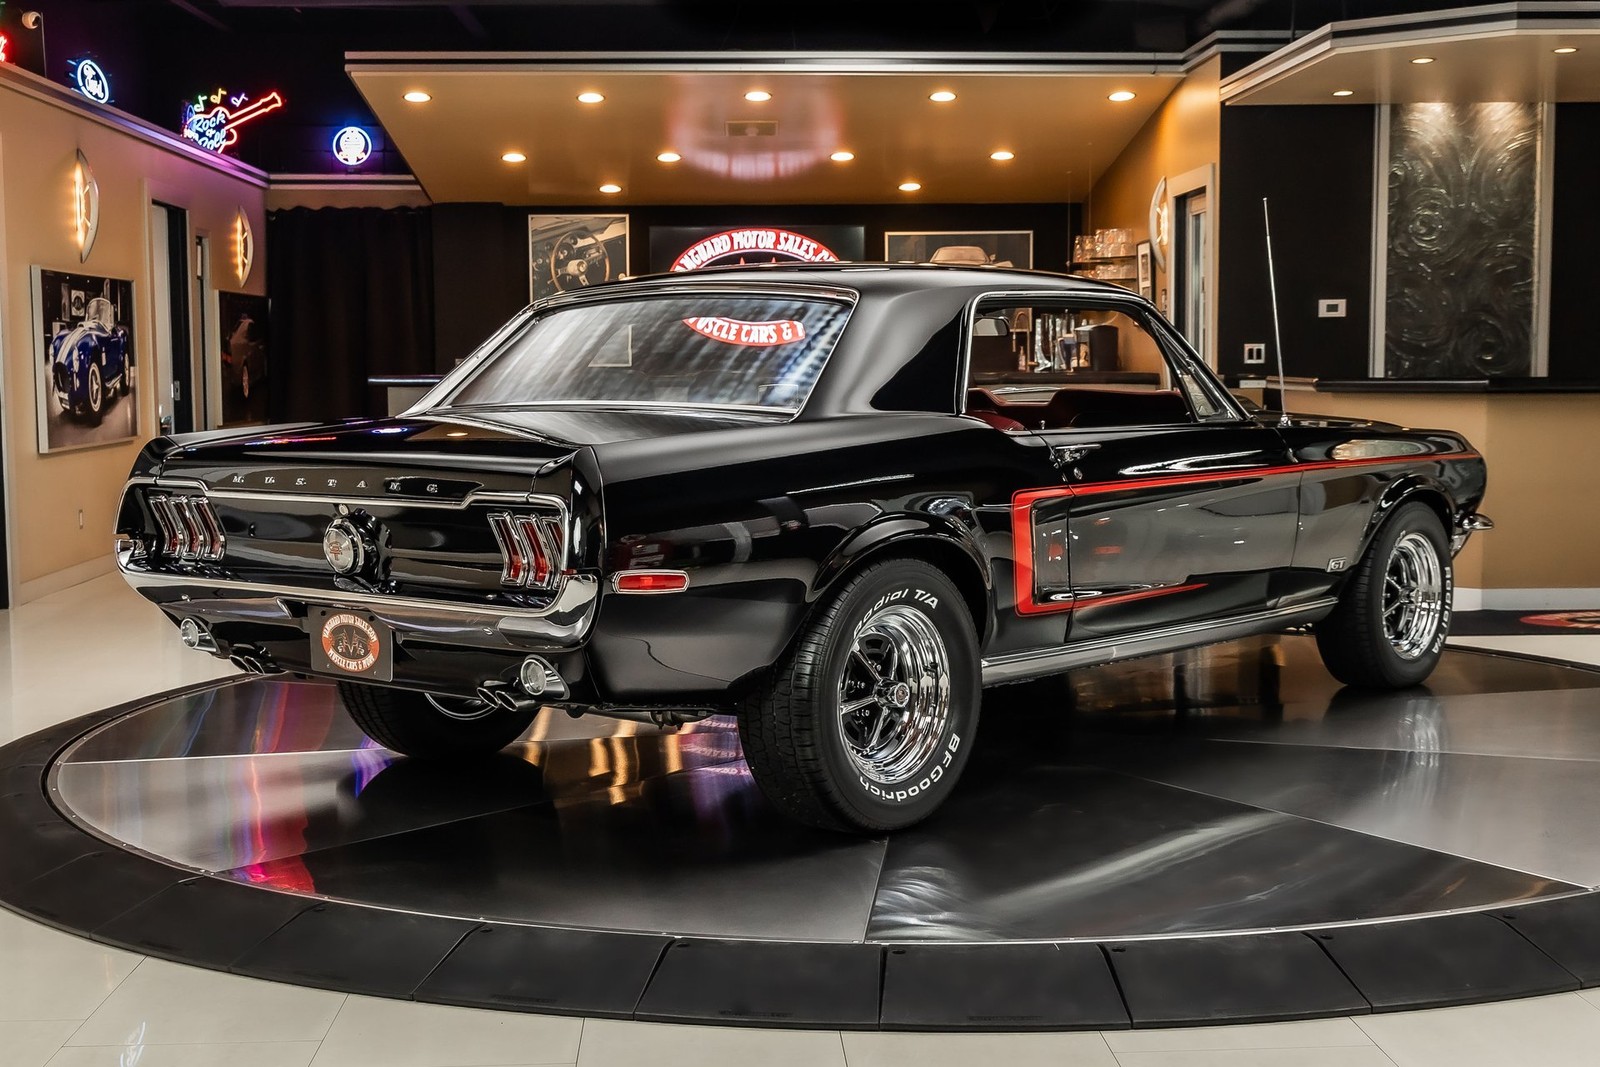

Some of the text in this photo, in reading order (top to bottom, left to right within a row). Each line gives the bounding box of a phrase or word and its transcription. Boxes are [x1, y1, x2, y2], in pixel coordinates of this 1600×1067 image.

[192, 109, 226, 133] Rock
[731, 230, 777, 250] MOTOR
[740, 324, 778, 344] CARS
[780, 322, 793, 341] &
[231, 475, 438, 494] MUSTANG
[914, 588, 939, 610] T/A
[860, 732, 961, 802] BFGoodrich
